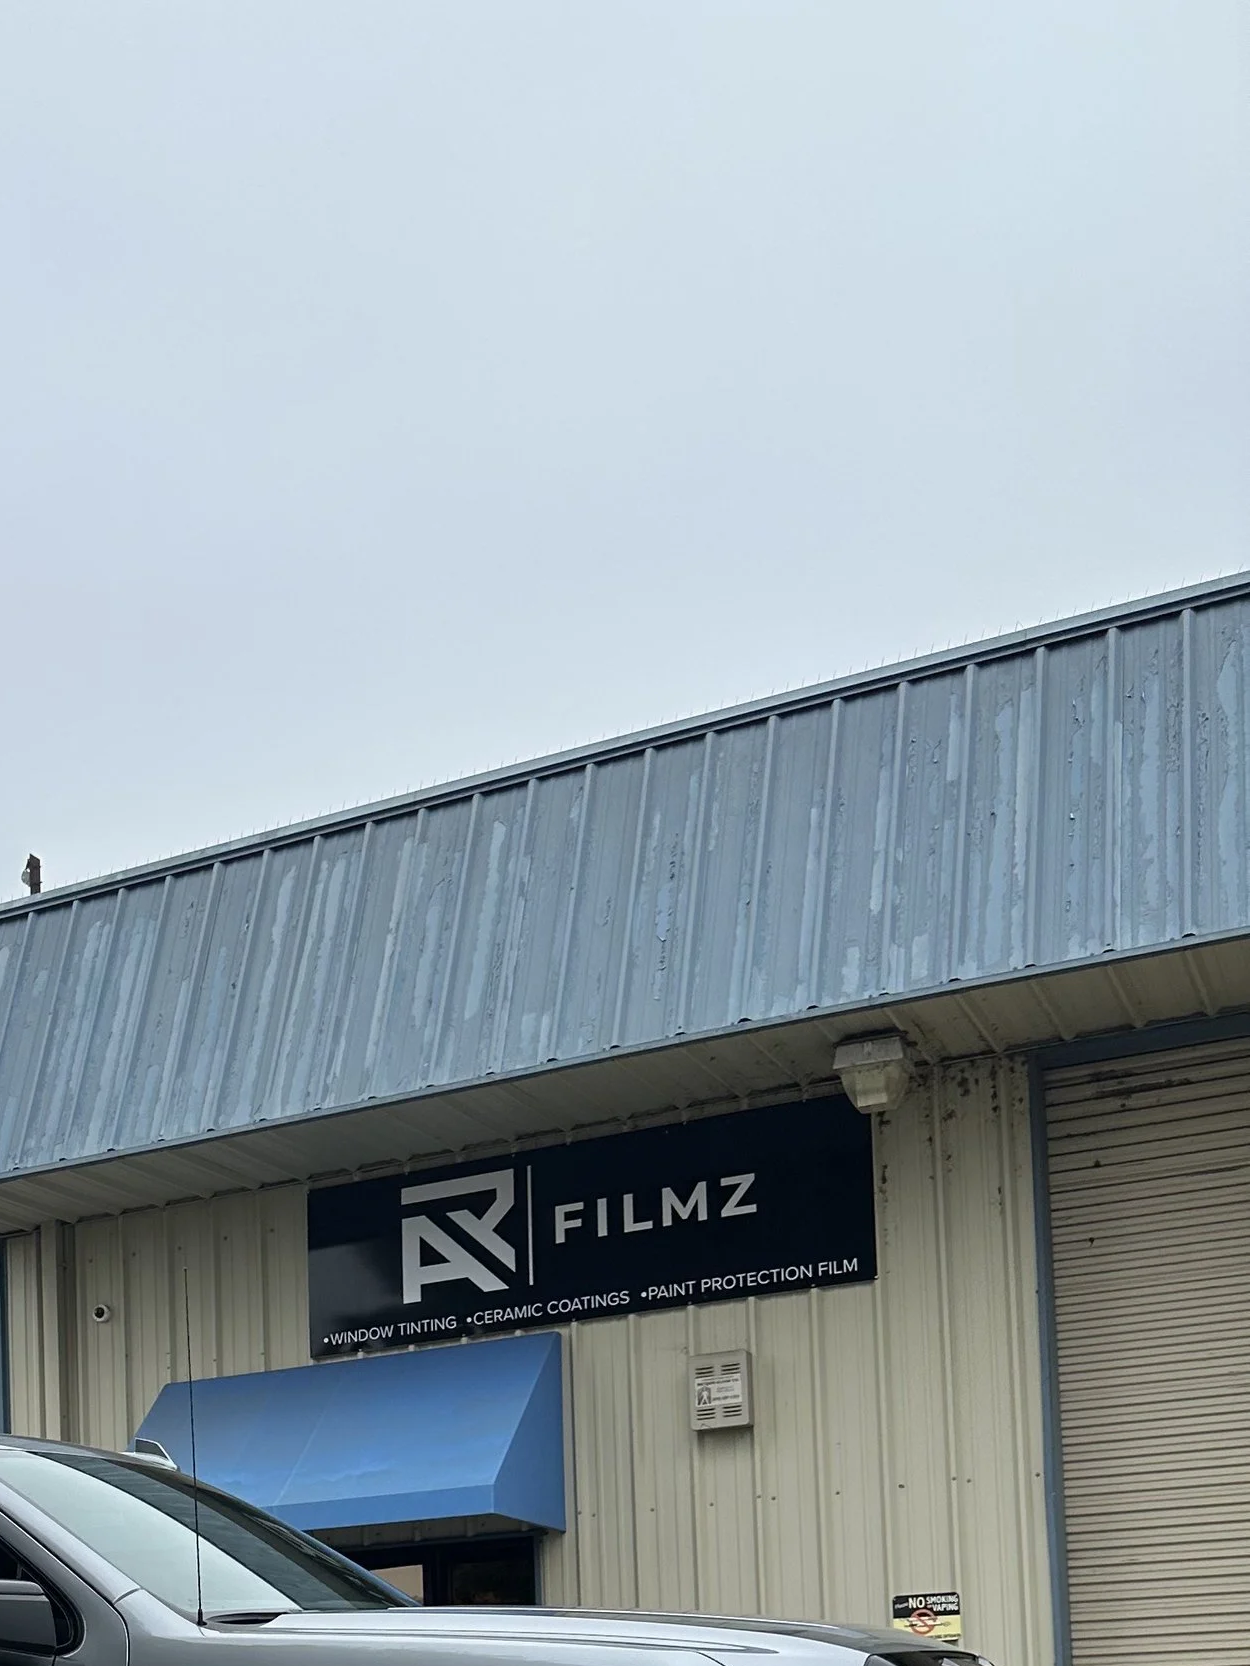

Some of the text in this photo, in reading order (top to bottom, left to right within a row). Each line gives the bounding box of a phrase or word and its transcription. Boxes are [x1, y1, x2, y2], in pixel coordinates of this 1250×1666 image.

[554, 1173, 758, 1245] FILMZ
[398, 1315, 458, 1336] TINTING
[547, 1290, 631, 1314] COATINGS
[700, 1263, 813, 1293] PROTECTION
[817, 1257, 859, 1276] FILM
[908, 1597, 925, 1608] NO
[926, 1594, 958, 1604] SMOKING
[932, 1602, 959, 1612] VAPING
